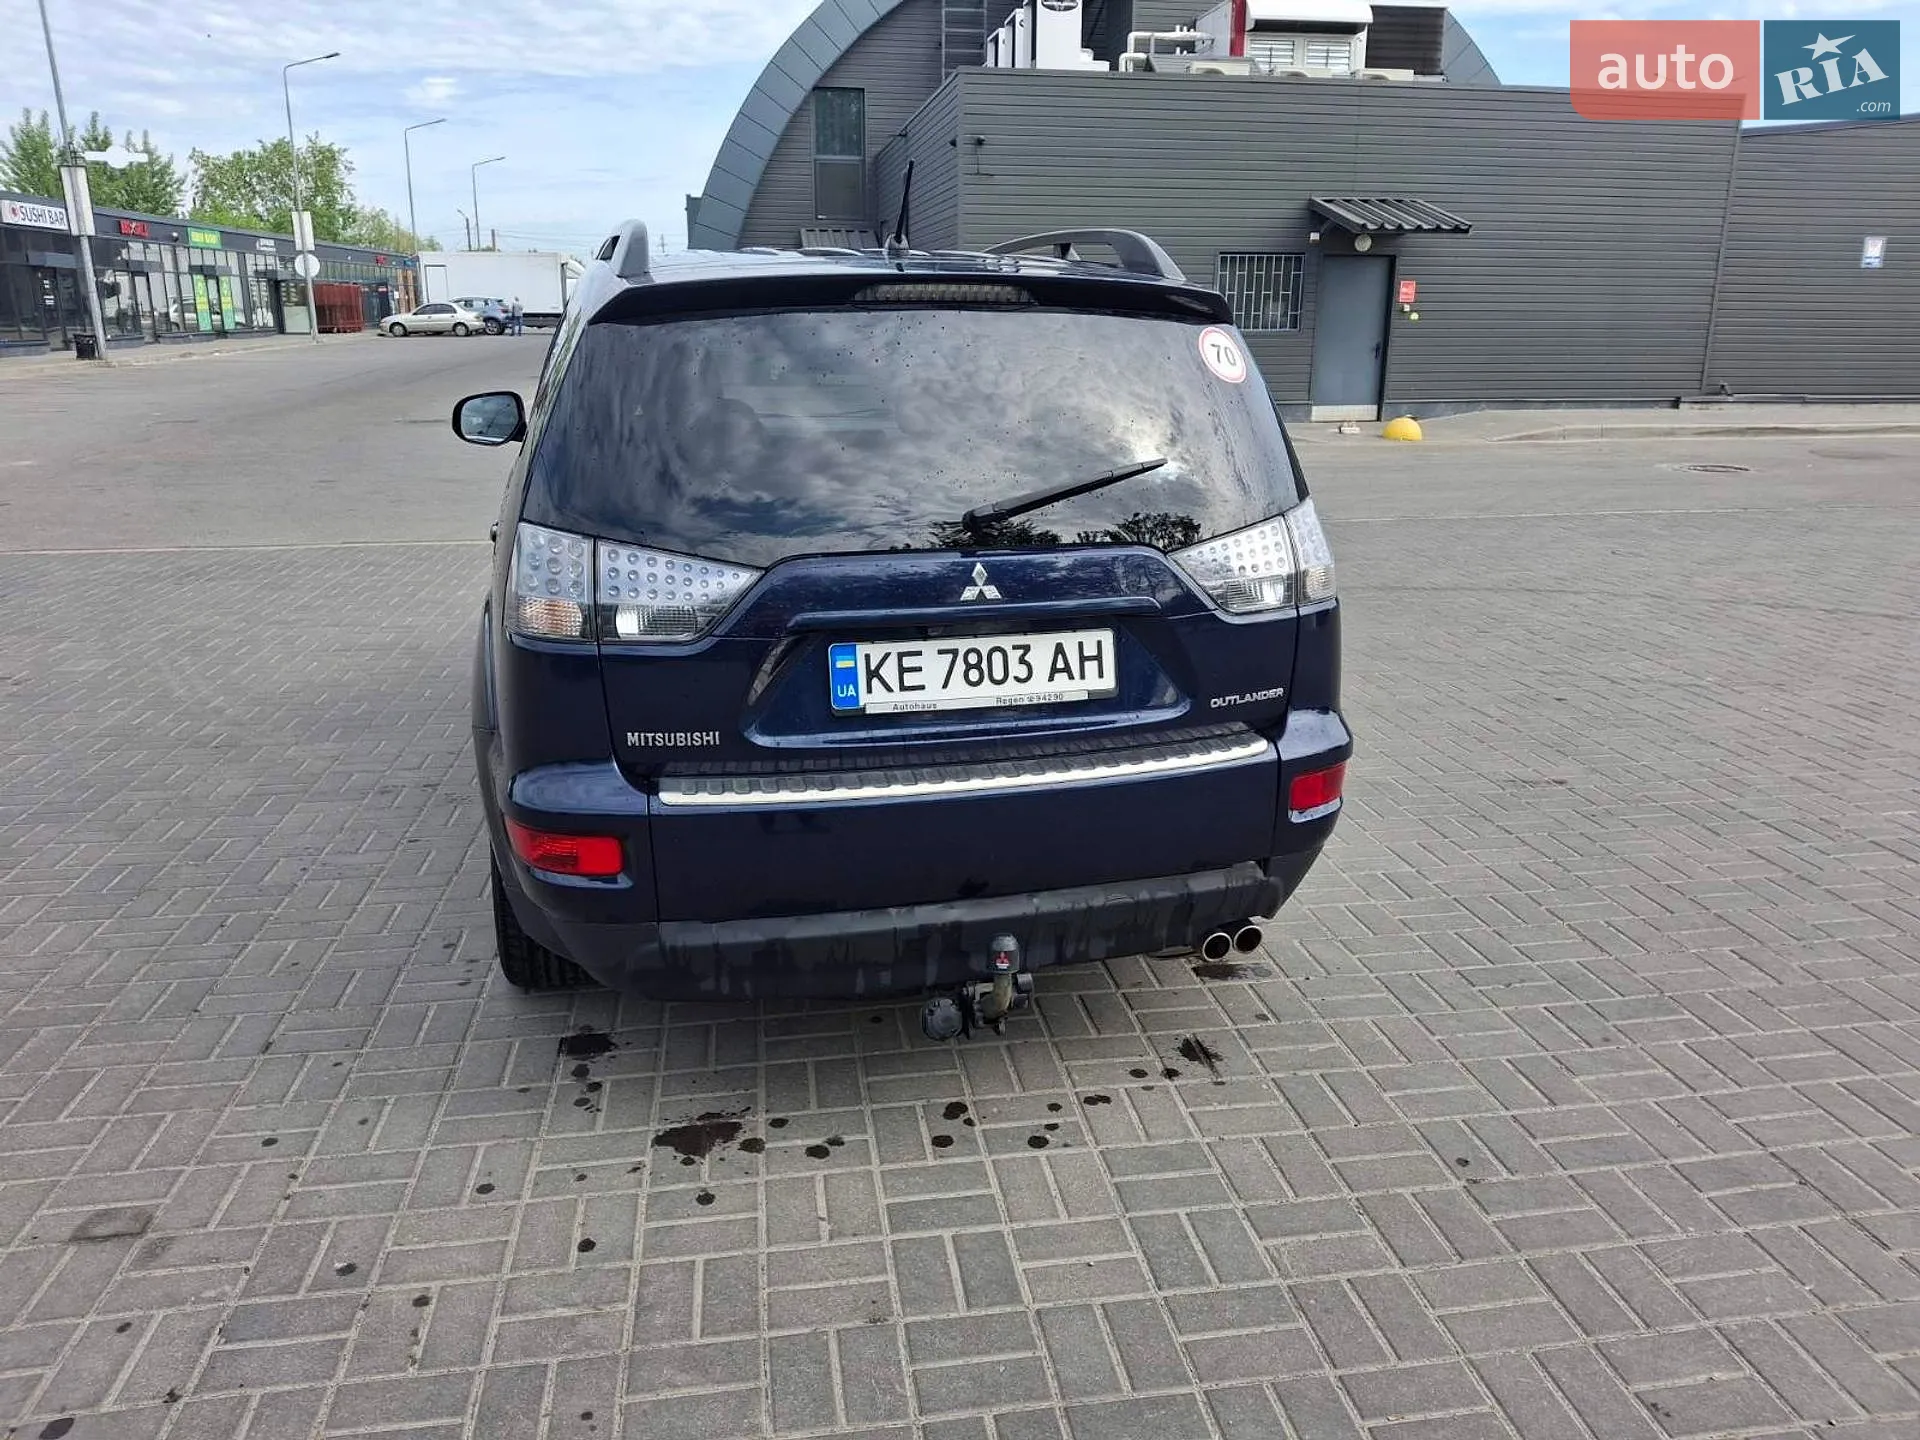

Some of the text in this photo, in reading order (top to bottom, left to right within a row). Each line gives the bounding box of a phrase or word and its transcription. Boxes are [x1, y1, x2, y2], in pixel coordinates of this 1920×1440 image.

[20, 205, 66, 226] SUSHI BAR
[1210, 343, 1237, 367] 70
[864, 639, 1105, 695] KE 7803 AH
[836, 684, 857, 698] UA
[1210, 687, 1284, 708] OUTLANDER
[892, 702, 938, 711] Autohaus
[626, 731, 720, 747] MITSUBISHI
